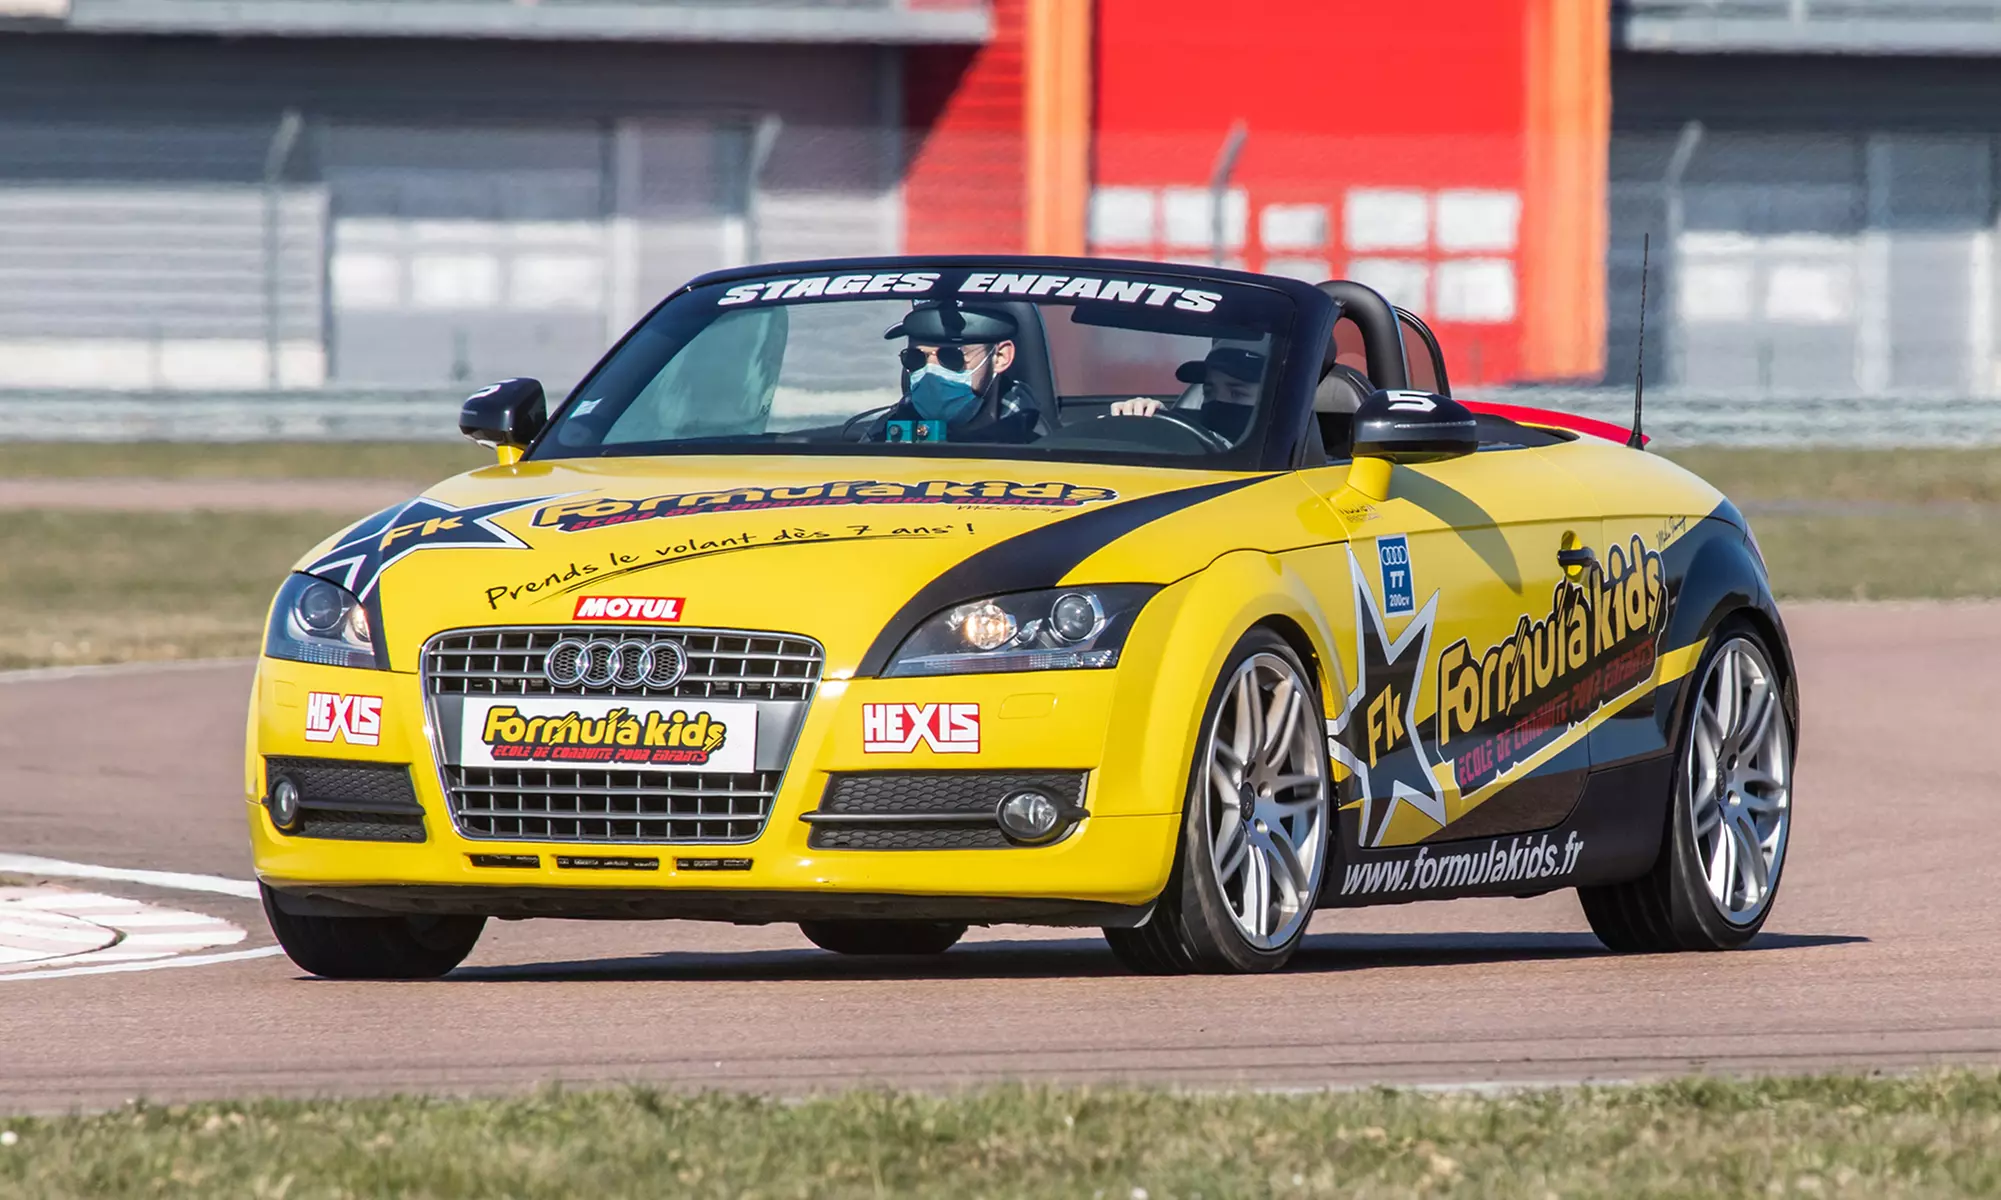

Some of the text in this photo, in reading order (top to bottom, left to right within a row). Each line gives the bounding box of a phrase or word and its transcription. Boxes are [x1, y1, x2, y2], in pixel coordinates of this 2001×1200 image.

[717, 273, 1222, 312] STAGES ENFANTS
[1386, 390, 1437, 412] 5
[537, 481, 1108, 527] Formula kids
[570, 511, 657, 531] ECOLE
[485, 563, 598, 610] Prends
[610, 552, 640, 567] le
[656, 532, 757, 556] volant
[773, 528, 830, 541] dès
[846, 525, 871, 536] 7
[1389, 570, 1405, 588] TT
[577, 598, 679, 619] MOTUL
[1440, 538, 1662, 746] Formula kids
[305, 692, 382, 745] HEXIS
[483, 706, 726, 751] Formula kids
[864, 704, 979, 752] HEXIS
[494, 745, 709, 763] ECOLE DE CONDUITE POUR ENFANTS
[1458, 739, 1493, 785] ECOLE
[1496, 728, 1511, 759] DE
[1340, 830, 1584, 895] www.formulakids.fr
